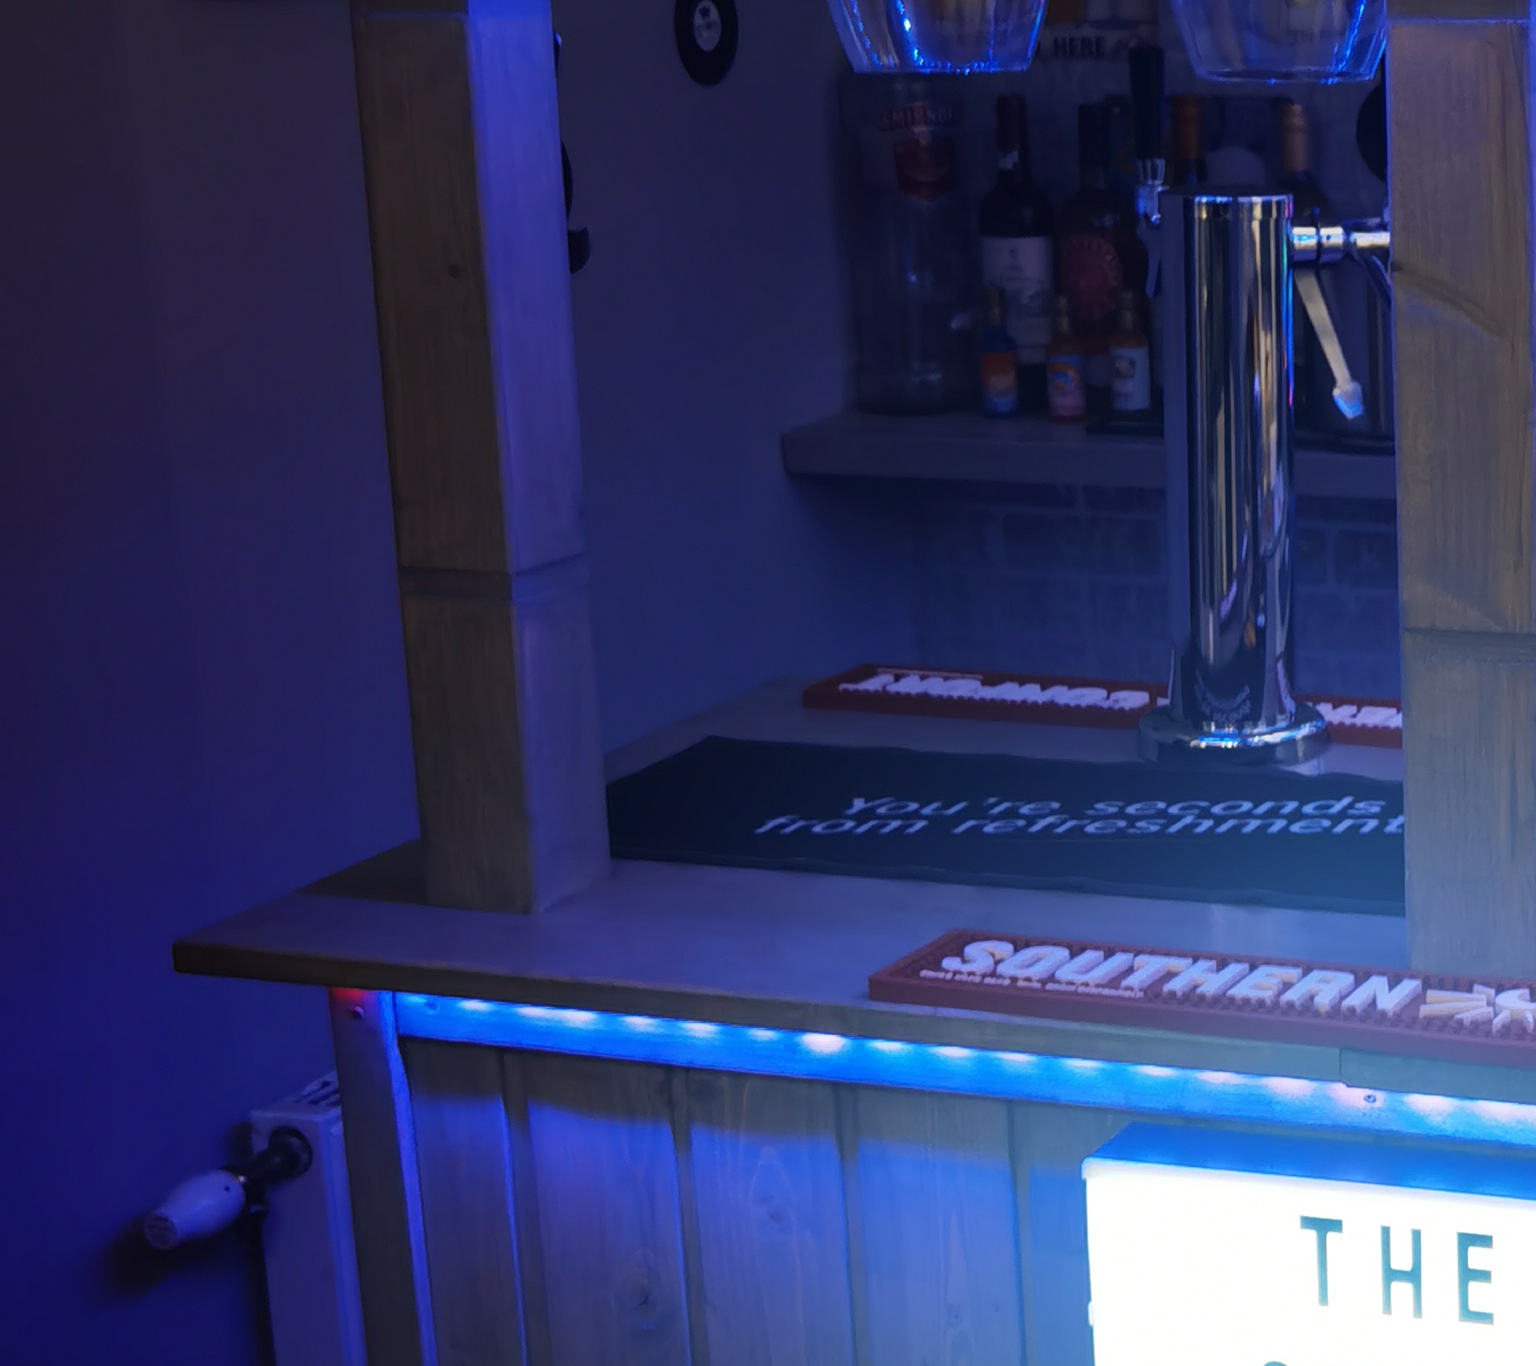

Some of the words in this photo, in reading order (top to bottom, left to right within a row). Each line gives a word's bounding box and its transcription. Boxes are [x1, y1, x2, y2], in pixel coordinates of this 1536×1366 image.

[1053, 37, 1105, 58] HERE
[844, 796, 1061, 816] You're
[1084, 796, 1385, 816] seconds
[753, 813, 928, 836] from
[951, 813, 1405, 835] refreshment
[941, 940, 1423, 1016] SOUTHERN
[1300, 1215, 1494, 1325] THE
